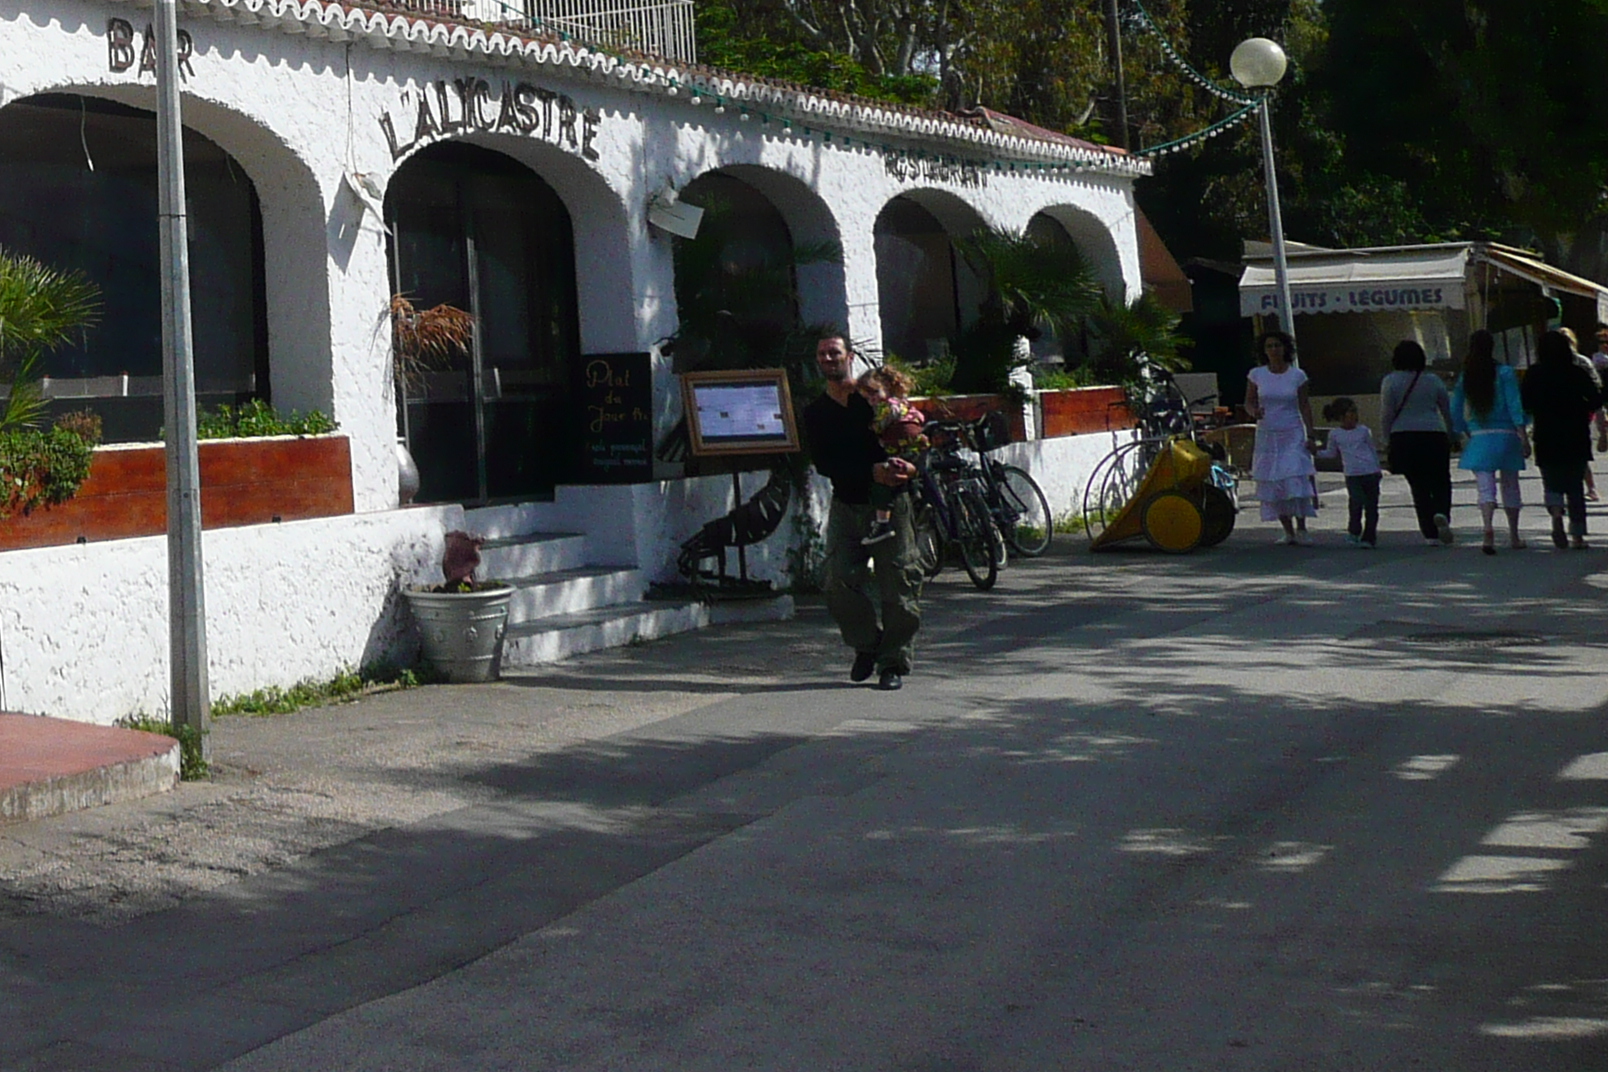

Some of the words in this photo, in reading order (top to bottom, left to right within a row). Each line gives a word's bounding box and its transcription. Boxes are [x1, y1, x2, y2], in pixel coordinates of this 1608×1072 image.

[107, 17, 196, 83] BAR
[378, 76, 602, 163] L'ALYCASTRE
[585, 359, 631, 389] Plat
